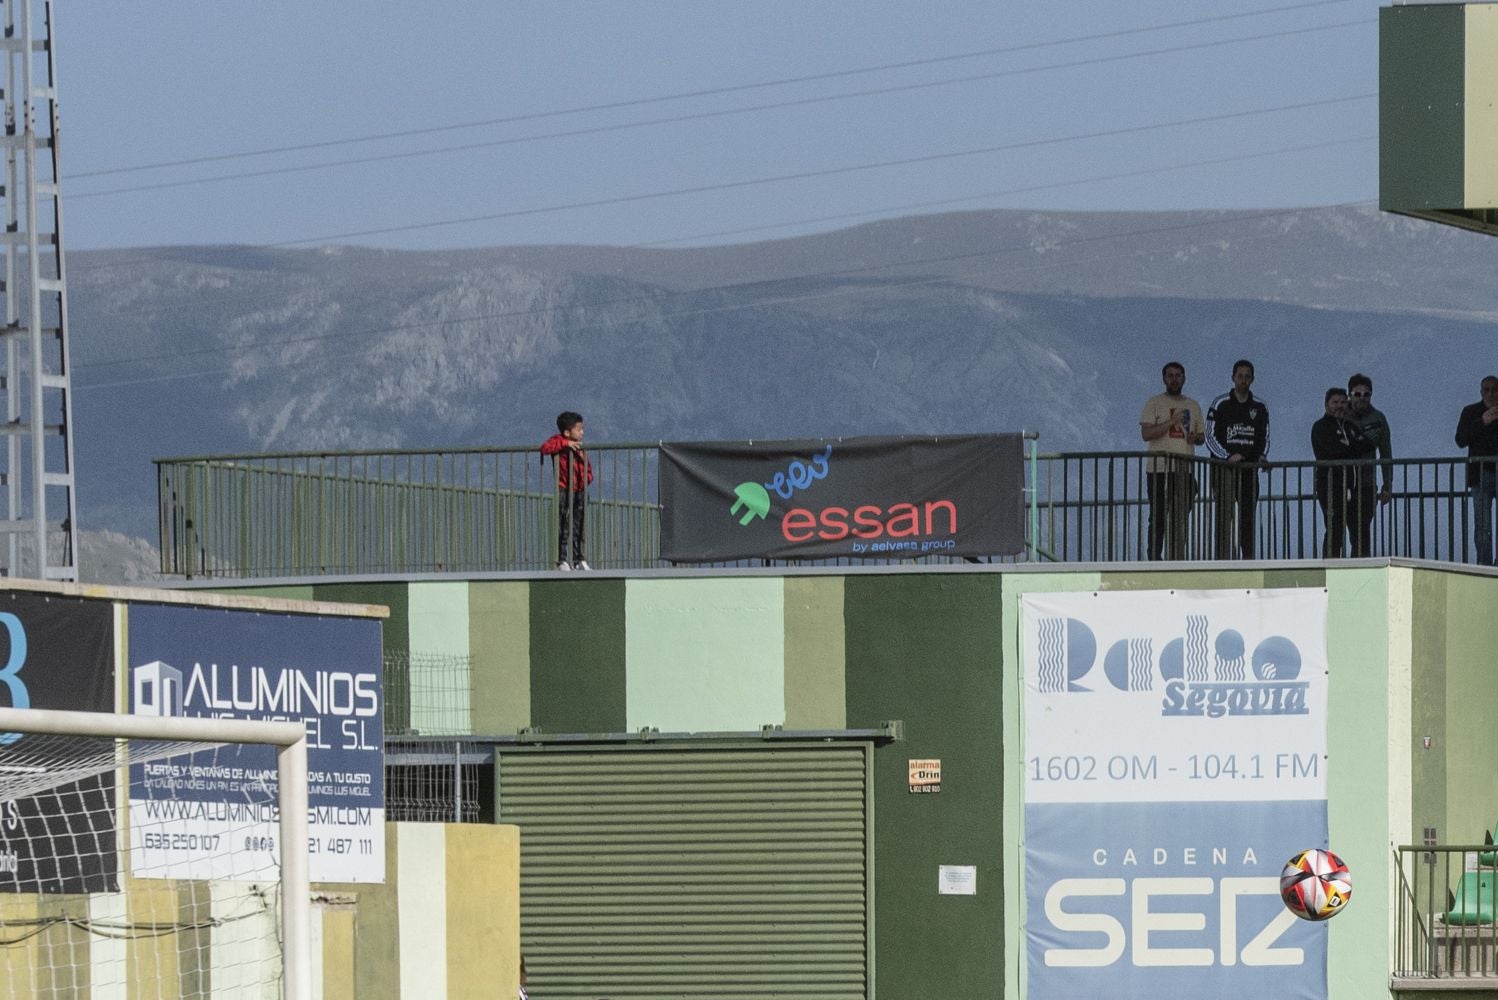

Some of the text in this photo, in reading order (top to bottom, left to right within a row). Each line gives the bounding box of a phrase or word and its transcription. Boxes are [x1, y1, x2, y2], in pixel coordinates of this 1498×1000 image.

[782, 500, 957, 542] essan
[852, 542, 869, 553] by
[921, 539, 956, 552] group
[1037, 614, 1302, 694] Radio
[183, 662, 378, 717] ALUMINIOS
[1161, 678, 1310, 718] Segovia
[341, 719, 378, 752] S.L.
[231, 768, 243, 779] DE
[325, 773, 333, 783] A
[333, 773, 345, 784] TU
[345, 774, 371, 785] GUSTO
[1030, 755, 1097, 782] 1602
[1107, 755, 1158, 781] OM
[1187, 754, 1265, 780] 104.1
[1275, 752, 1318, 779] FM
[145, 833, 173, 850] 635
[172, 834, 196, 850] 250
[200, 835, 220, 852] 107
[327, 839, 353, 853] 487
[359, 839, 373, 855] 111
[1093, 847, 1258, 866] CADENA
